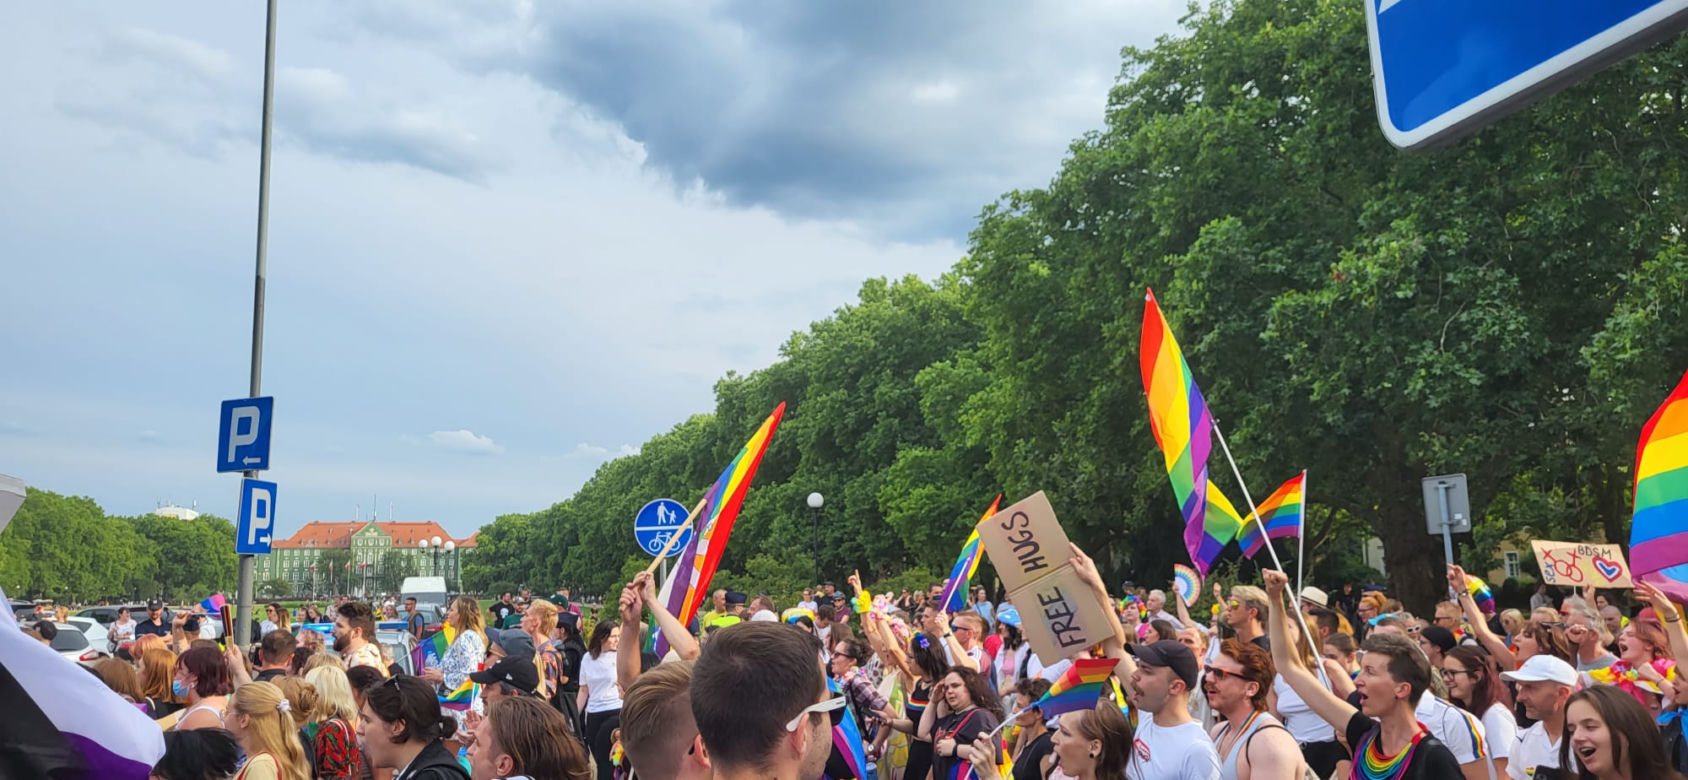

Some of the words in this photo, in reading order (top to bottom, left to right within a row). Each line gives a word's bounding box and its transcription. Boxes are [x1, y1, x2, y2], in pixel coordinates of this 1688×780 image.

[228, 406, 260, 463] P
[247, 487, 271, 546] P
[1001, 511, 1049, 574] HUGS
[1578, 545, 1611, 560] BDSM
[1037, 586, 1087, 648] FREE
